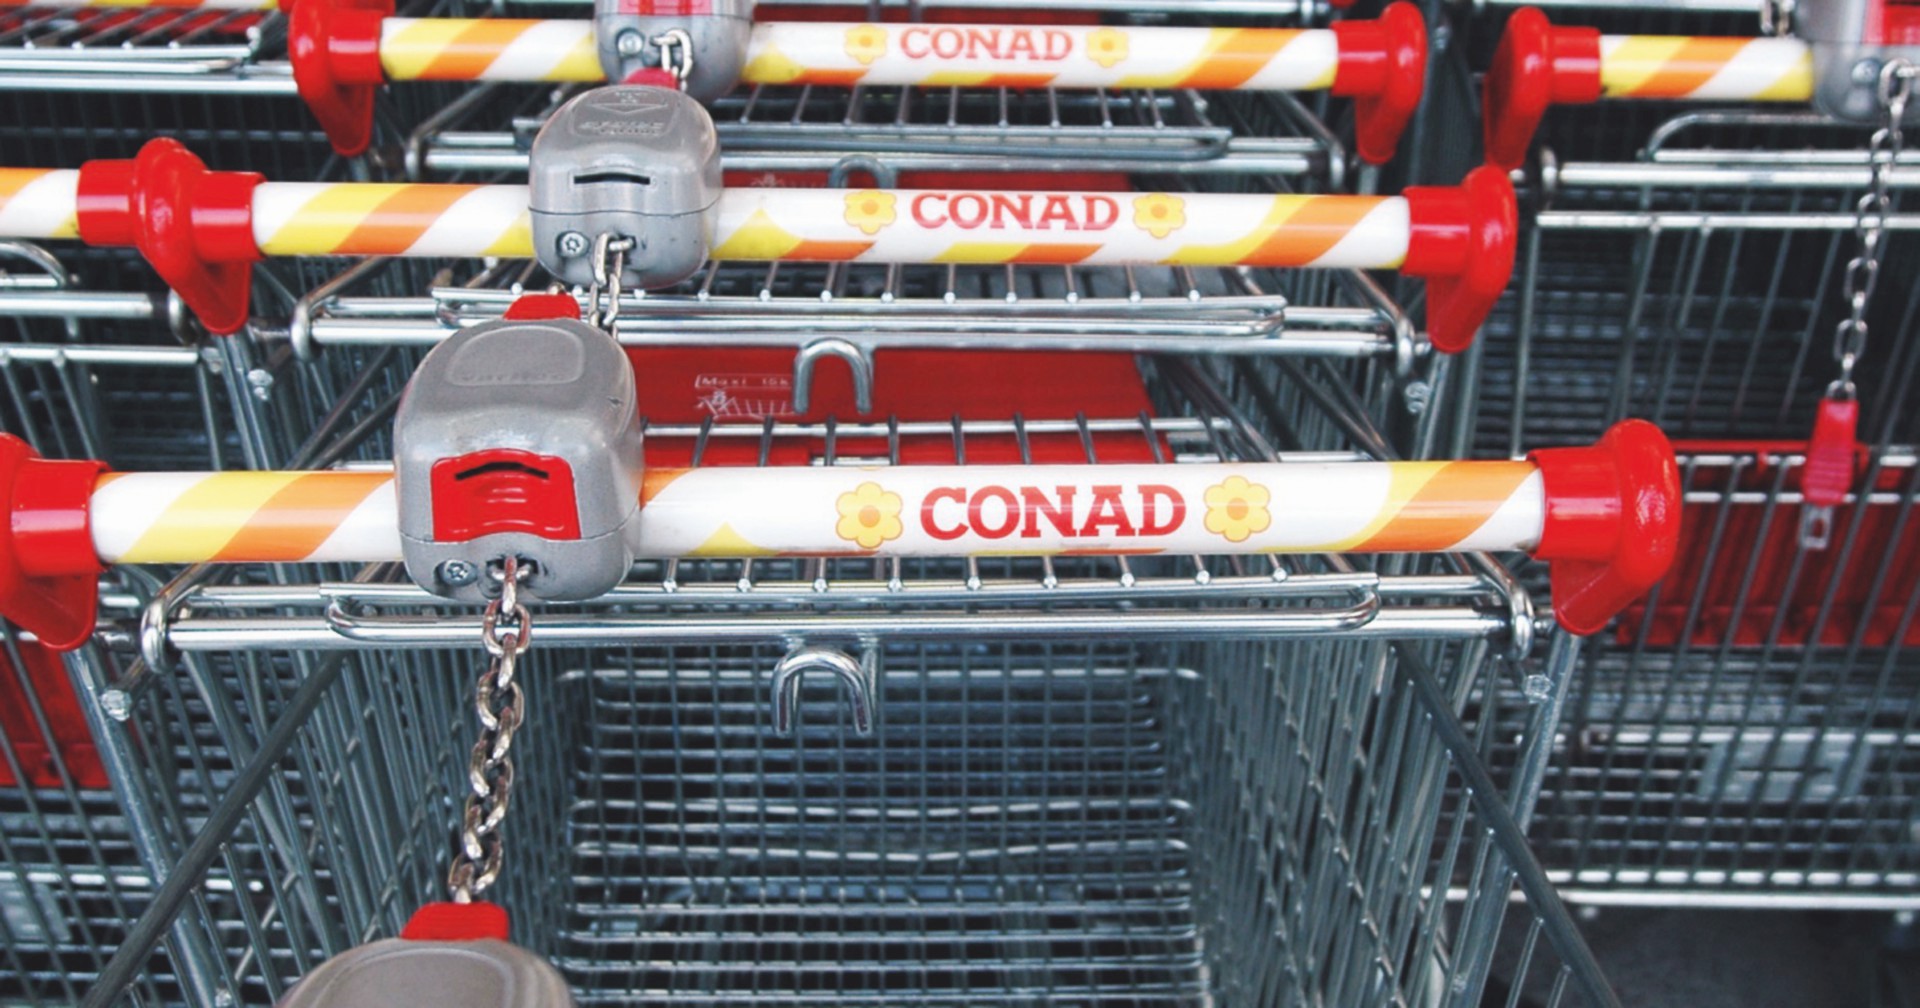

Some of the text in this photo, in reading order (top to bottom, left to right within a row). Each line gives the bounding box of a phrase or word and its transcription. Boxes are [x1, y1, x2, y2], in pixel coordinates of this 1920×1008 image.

[900, 27, 1073, 61] CONAD
[911, 192, 1119, 231] CONAD
[920, 484, 1187, 541] CONAD
